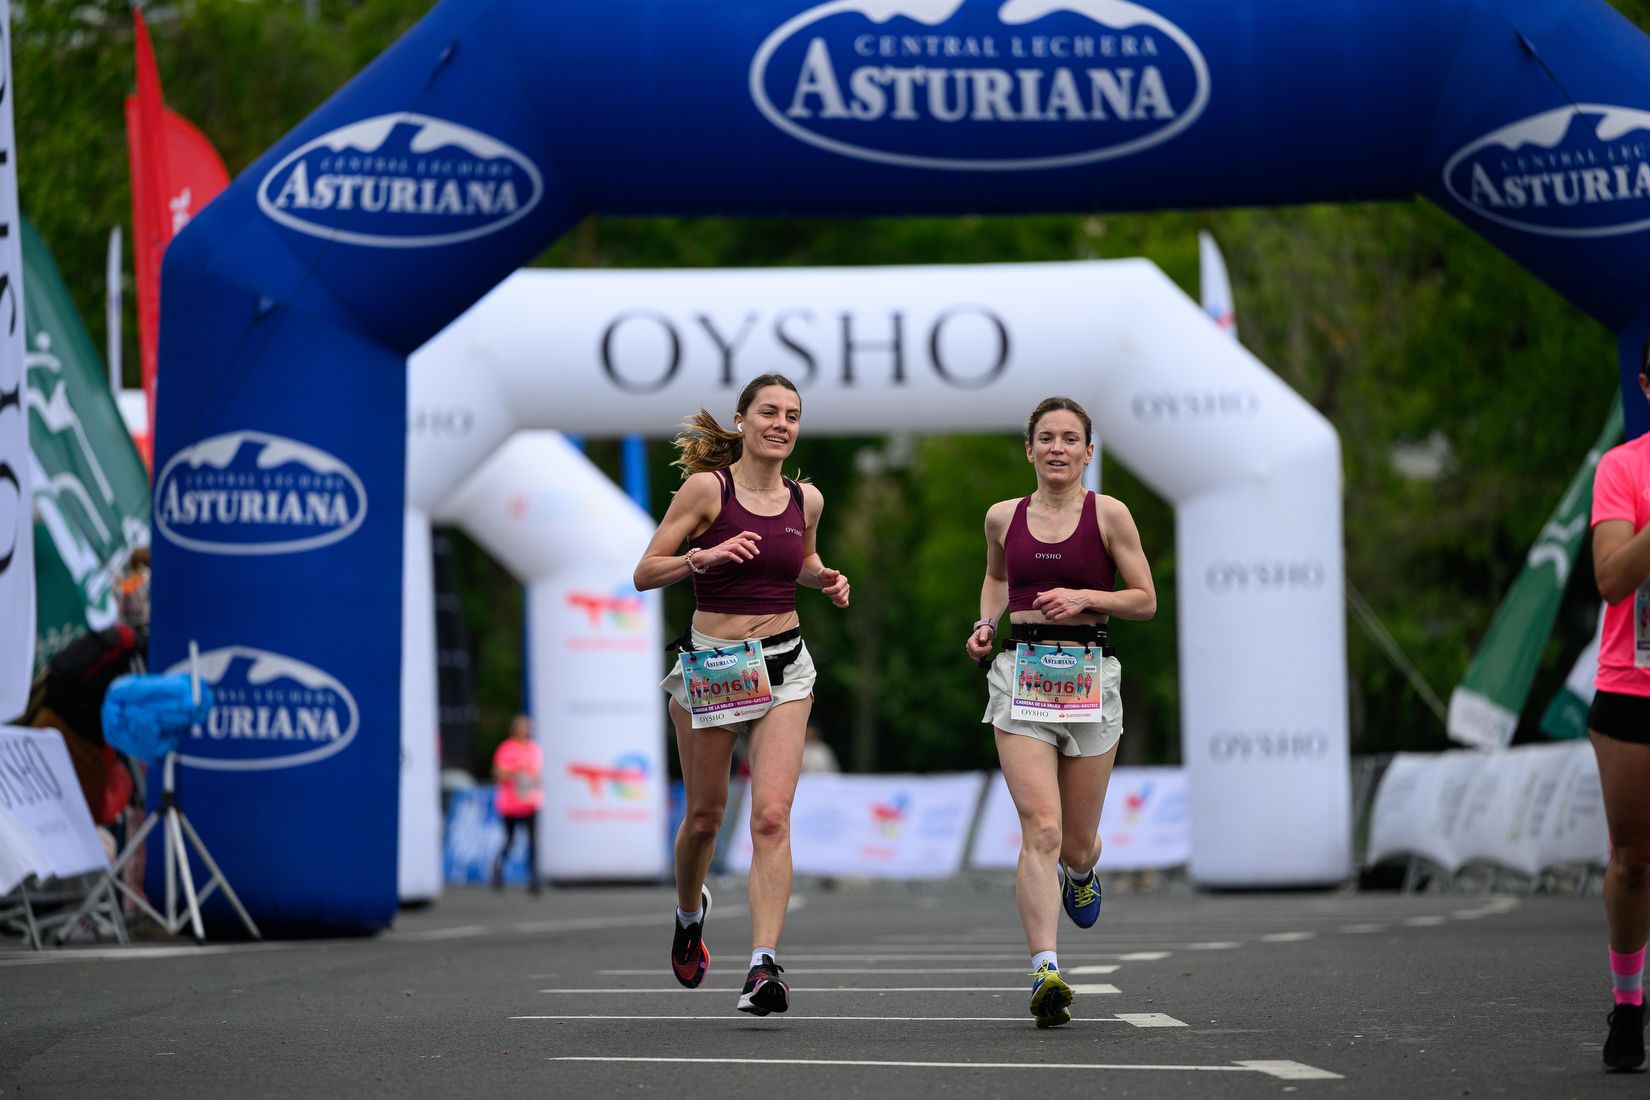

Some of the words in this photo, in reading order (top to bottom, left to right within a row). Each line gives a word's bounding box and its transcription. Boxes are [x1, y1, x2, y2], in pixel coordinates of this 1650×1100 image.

[854, 34, 1000, 58] CENTRAL
[1011, 35, 1159, 58] LECHERA
[786, 36, 1177, 122] ASTURIANA
[273, 159, 519, 215] ASTURIANA
[1471, 160, 1650, 207] ASTURIA
[596, 301, 1013, 396] OYSHO
[161, 475, 350, 525] ASTURIANA
[1035, 552, 1062, 560] OYSHO
[705, 658, 737, 668] ASTURIANA
[1043, 656, 1076, 665] ASTURIANA
[710, 679, 743, 695] 016
[1042, 680, 1074, 694] 016
[699, 713, 725, 723] OYSHO
[741, 708, 766, 716] Santander
[1021, 708, 1049, 718] OYSHO
[191, 705, 341, 741] URIANA
